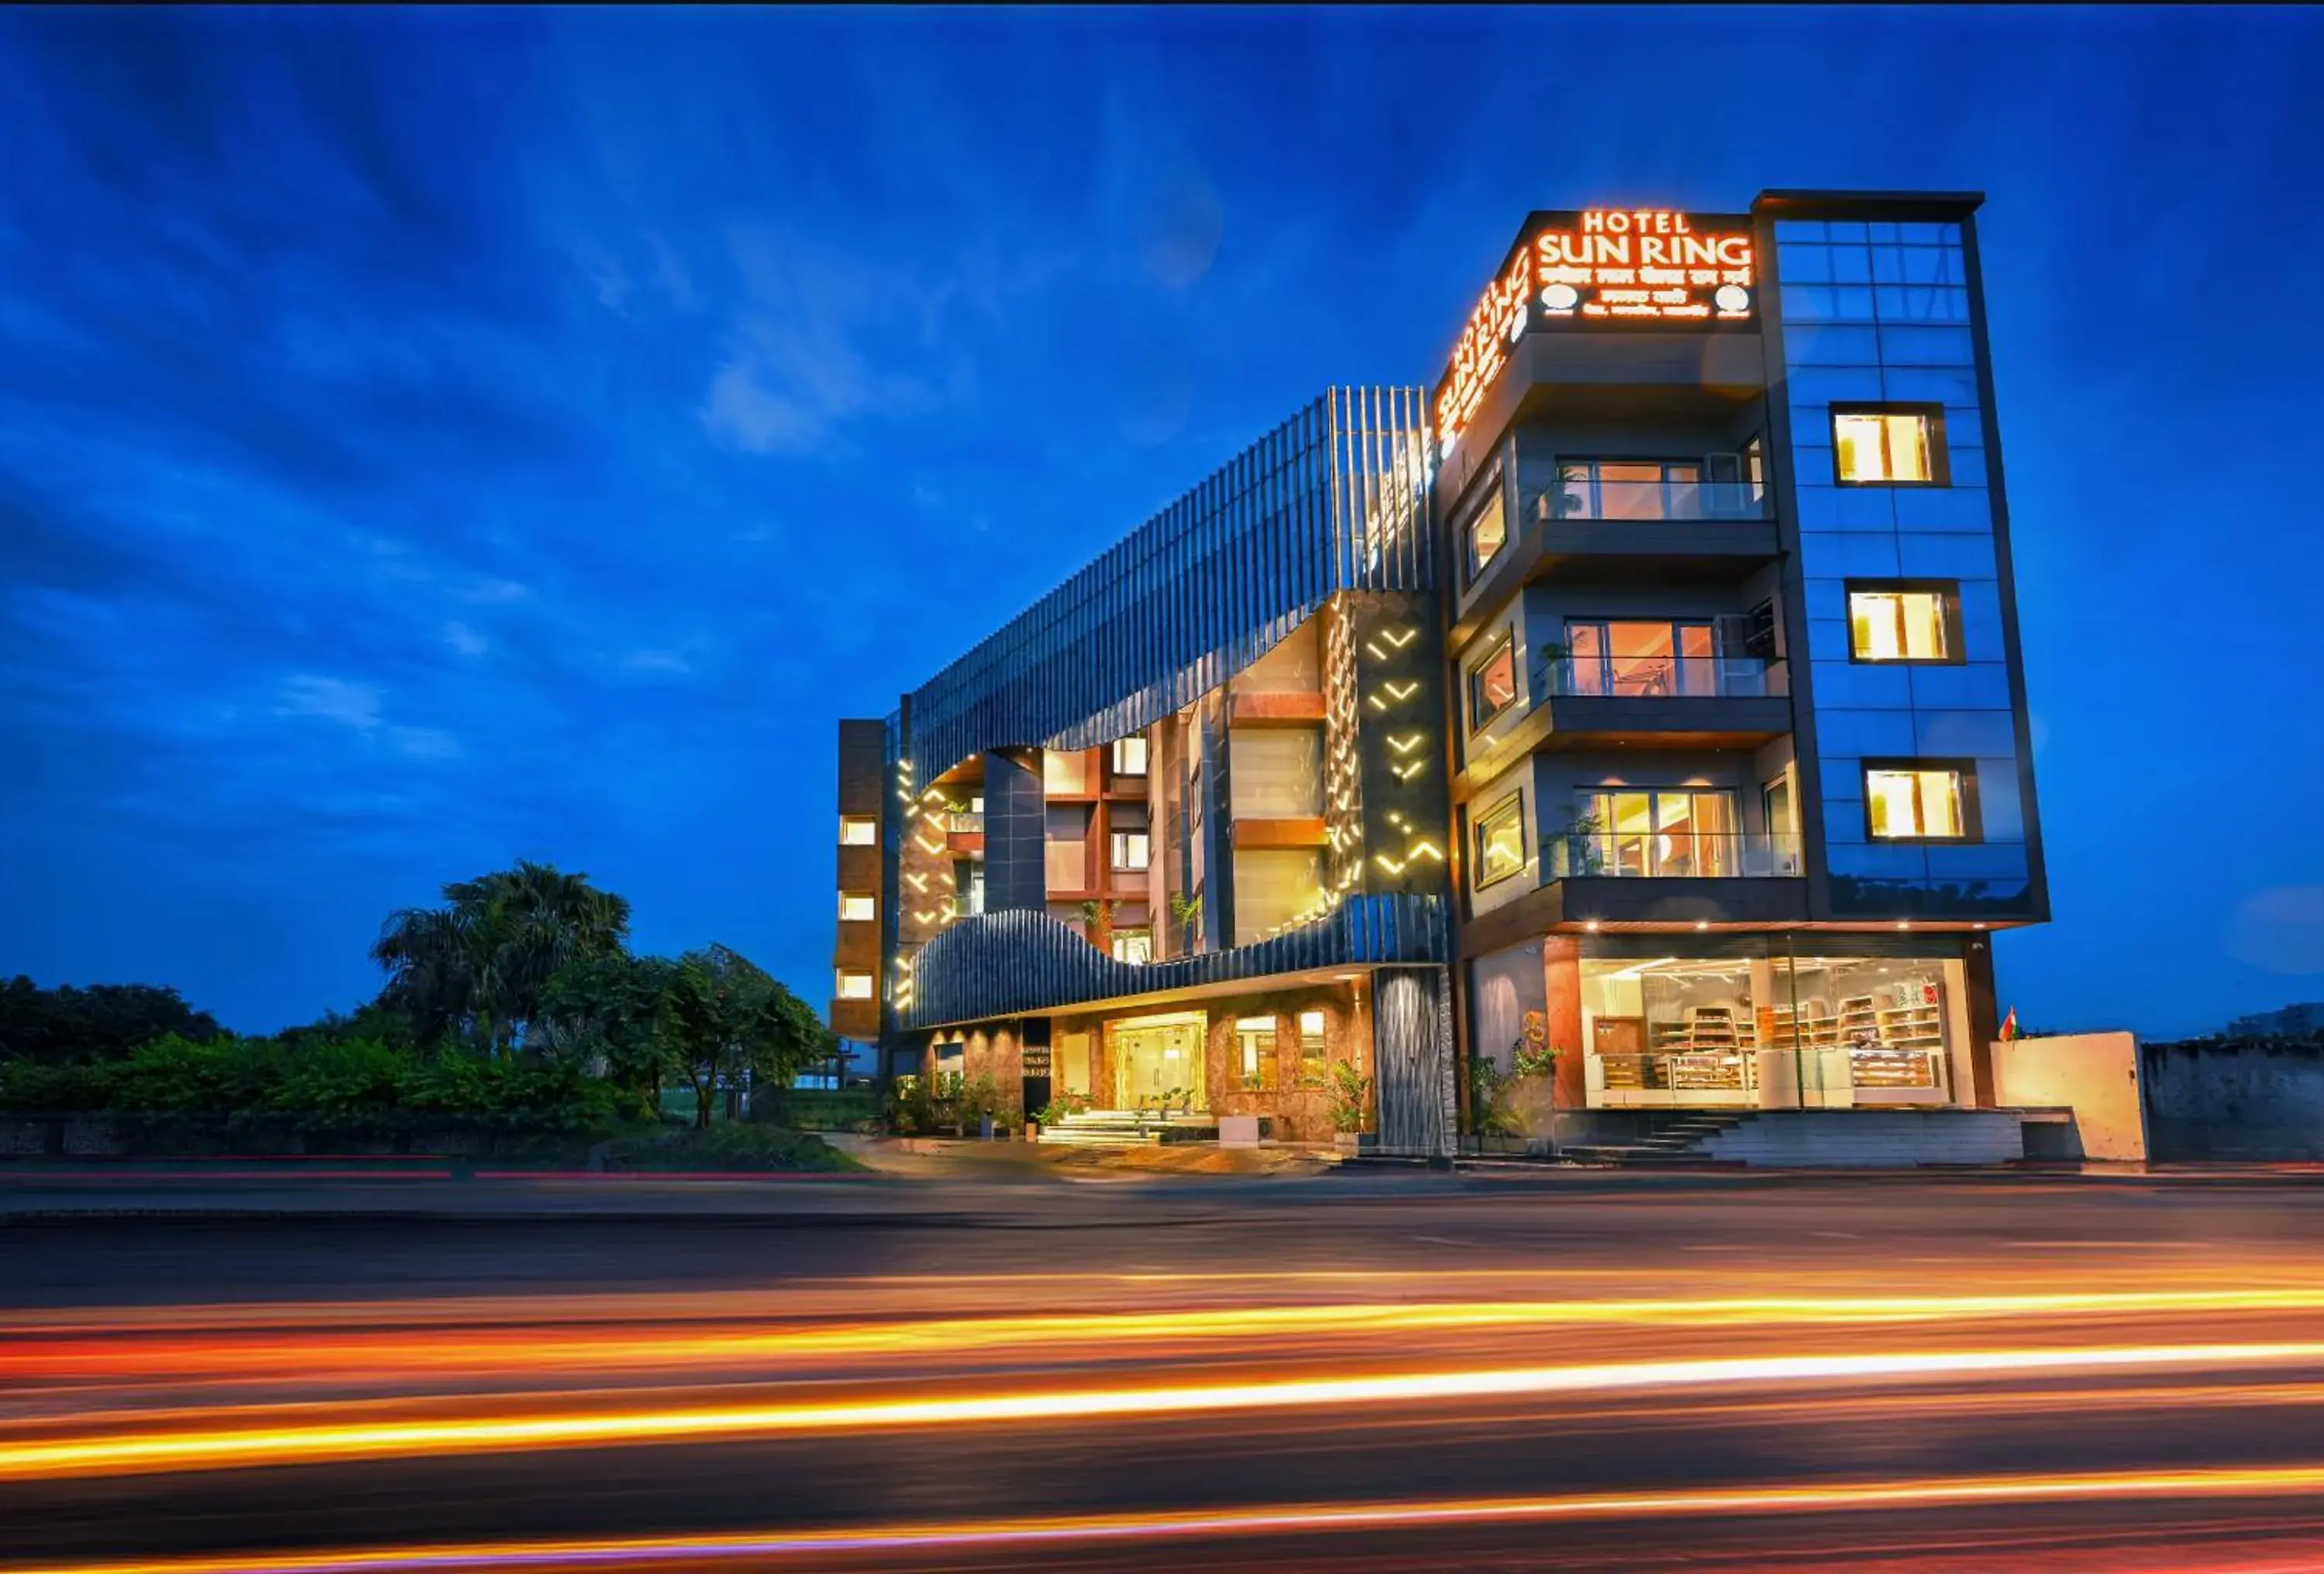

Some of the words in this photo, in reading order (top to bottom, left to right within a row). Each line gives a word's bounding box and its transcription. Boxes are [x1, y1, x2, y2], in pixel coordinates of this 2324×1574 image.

[1538, 235, 1629, 264] SUN
[1640, 236, 1752, 265] RING
[1583, 211, 1690, 233] HOTEL
[1454, 281, 1499, 369] HOTEL
[1477, 246, 1530, 356] RING
